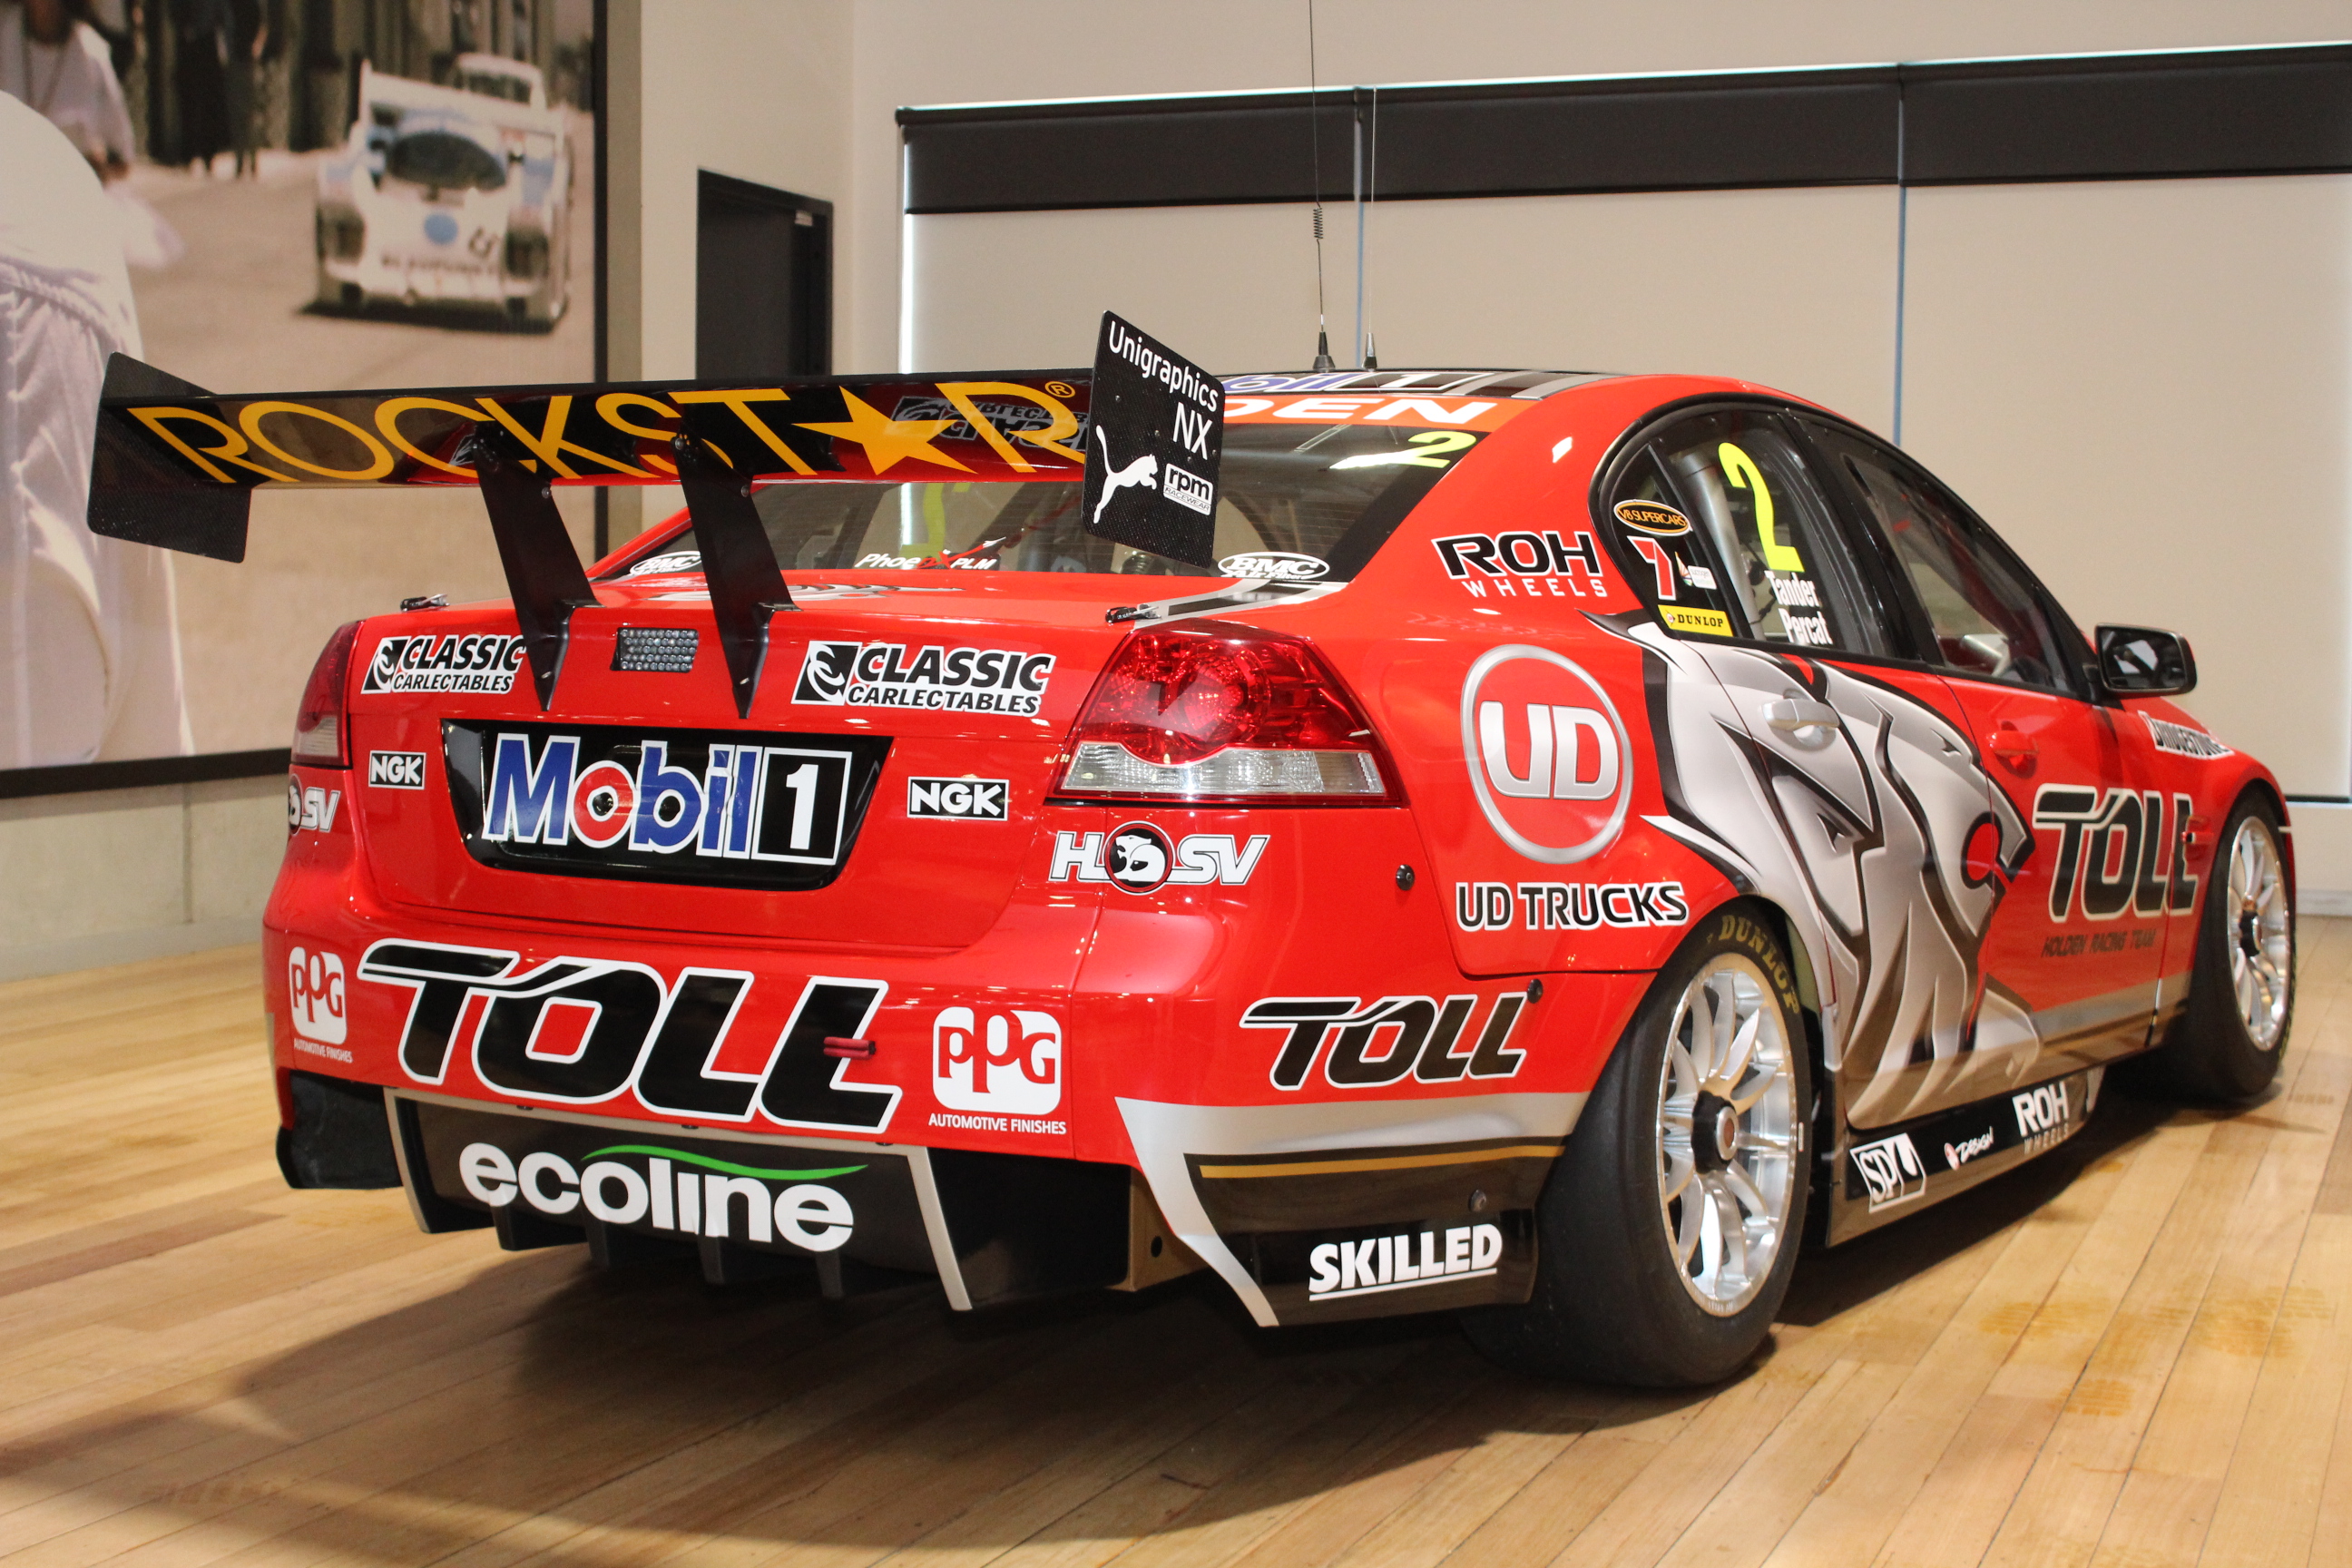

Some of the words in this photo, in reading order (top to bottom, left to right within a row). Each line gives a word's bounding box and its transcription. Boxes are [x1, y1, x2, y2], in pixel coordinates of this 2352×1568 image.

[1109, 320, 1219, 412] Unigraphics
[1172, 402, 1213, 460] NX
[1397, 431, 1477, 468] 2
[1163, 485, 1210, 513] RACEWEAR
[1167, 466, 1211, 501] rpm
[1617, 508, 1632, 521] V8
[1632, 509, 1687, 527] SUPERCARS
[1719, 442, 1805, 573] 2
[949, 558, 998, 570] PLM
[1226, 557, 1320, 575] BMC
[1431, 530, 1603, 580] ROH
[1461, 577, 1608, 598] WHEELS
[1764, 570, 1820, 608] Tander
[1676, 612, 1724, 628] DUNLOP
[1778, 607, 1834, 645] Percat
[400, 634, 528, 672] CLASSIC
[855, 643, 1056, 692] CLASSIC
[392, 672, 514, 694] CARLECTABLES
[847, 684, 1041, 716] CARLECTABLES
[1479, 700, 1620, 801] UD
[369, 753, 423, 787] NGK
[482, 733, 763, 859] Mobil
[786, 763, 818, 851] 1
[910, 782, 1003, 818] NGK
[2032, 782, 2199, 924] TOLL
[1455, 881, 1514, 932] UD
[1516, 880, 1690, 931] TRUCKS
[1718, 914, 1801, 1014] DUNLOP
[357, 937, 904, 1134] TOLL
[1239, 992, 1528, 1092] TOLL
[927, 1112, 1008, 1132] AUTOMOTIVE
[1010, 1118, 1068, 1135] FINISHES
[2012, 1080, 2070, 1138] ROH
[459, 1142, 854, 1252] ecoline
[1308, 1223, 1504, 1295] SKILLED
